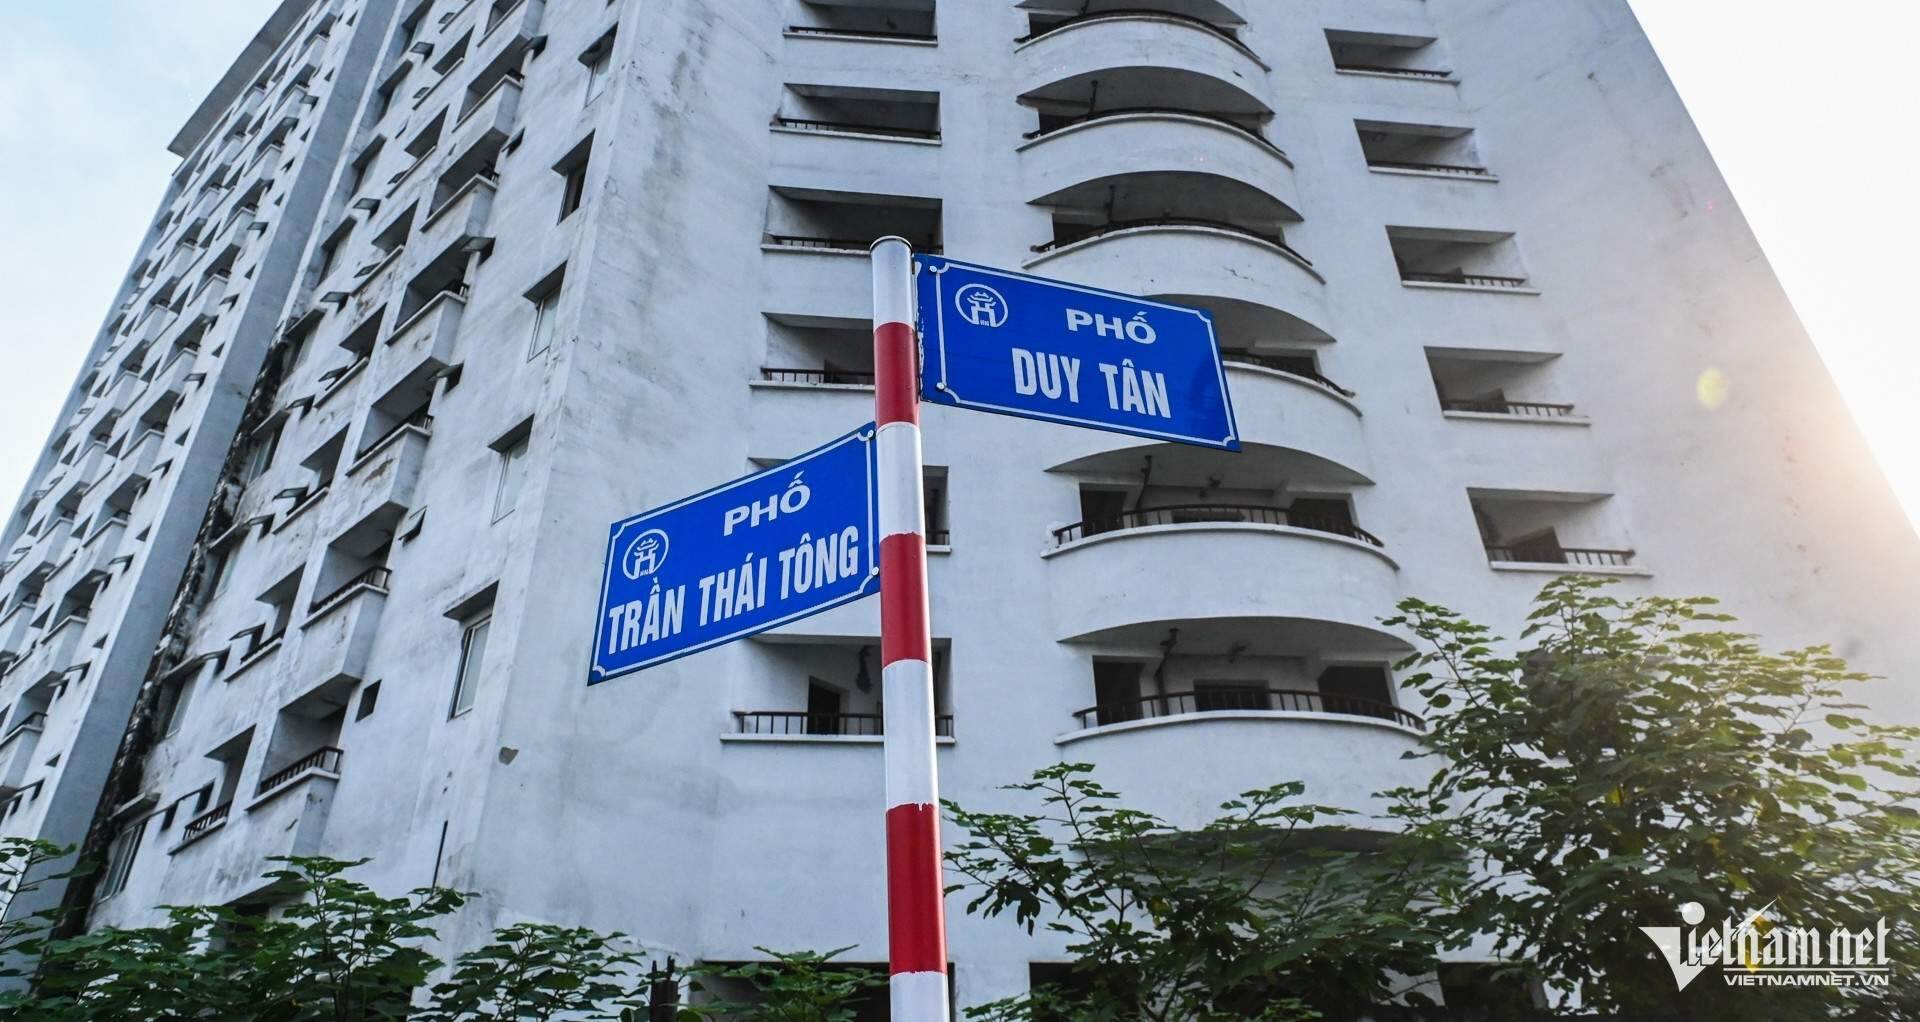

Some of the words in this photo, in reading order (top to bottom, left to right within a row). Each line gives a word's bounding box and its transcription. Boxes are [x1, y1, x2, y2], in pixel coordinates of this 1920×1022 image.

[1066, 308, 1156, 345] PHỐ
[1012, 347, 1080, 403] DUY
[1099, 358, 1171, 419] TÂN
[723, 471, 811, 536] PHỐ
[608, 577, 686, 655] TRẦN
[699, 552, 768, 626] THÁI
[778, 526, 859, 600] TÔNG
